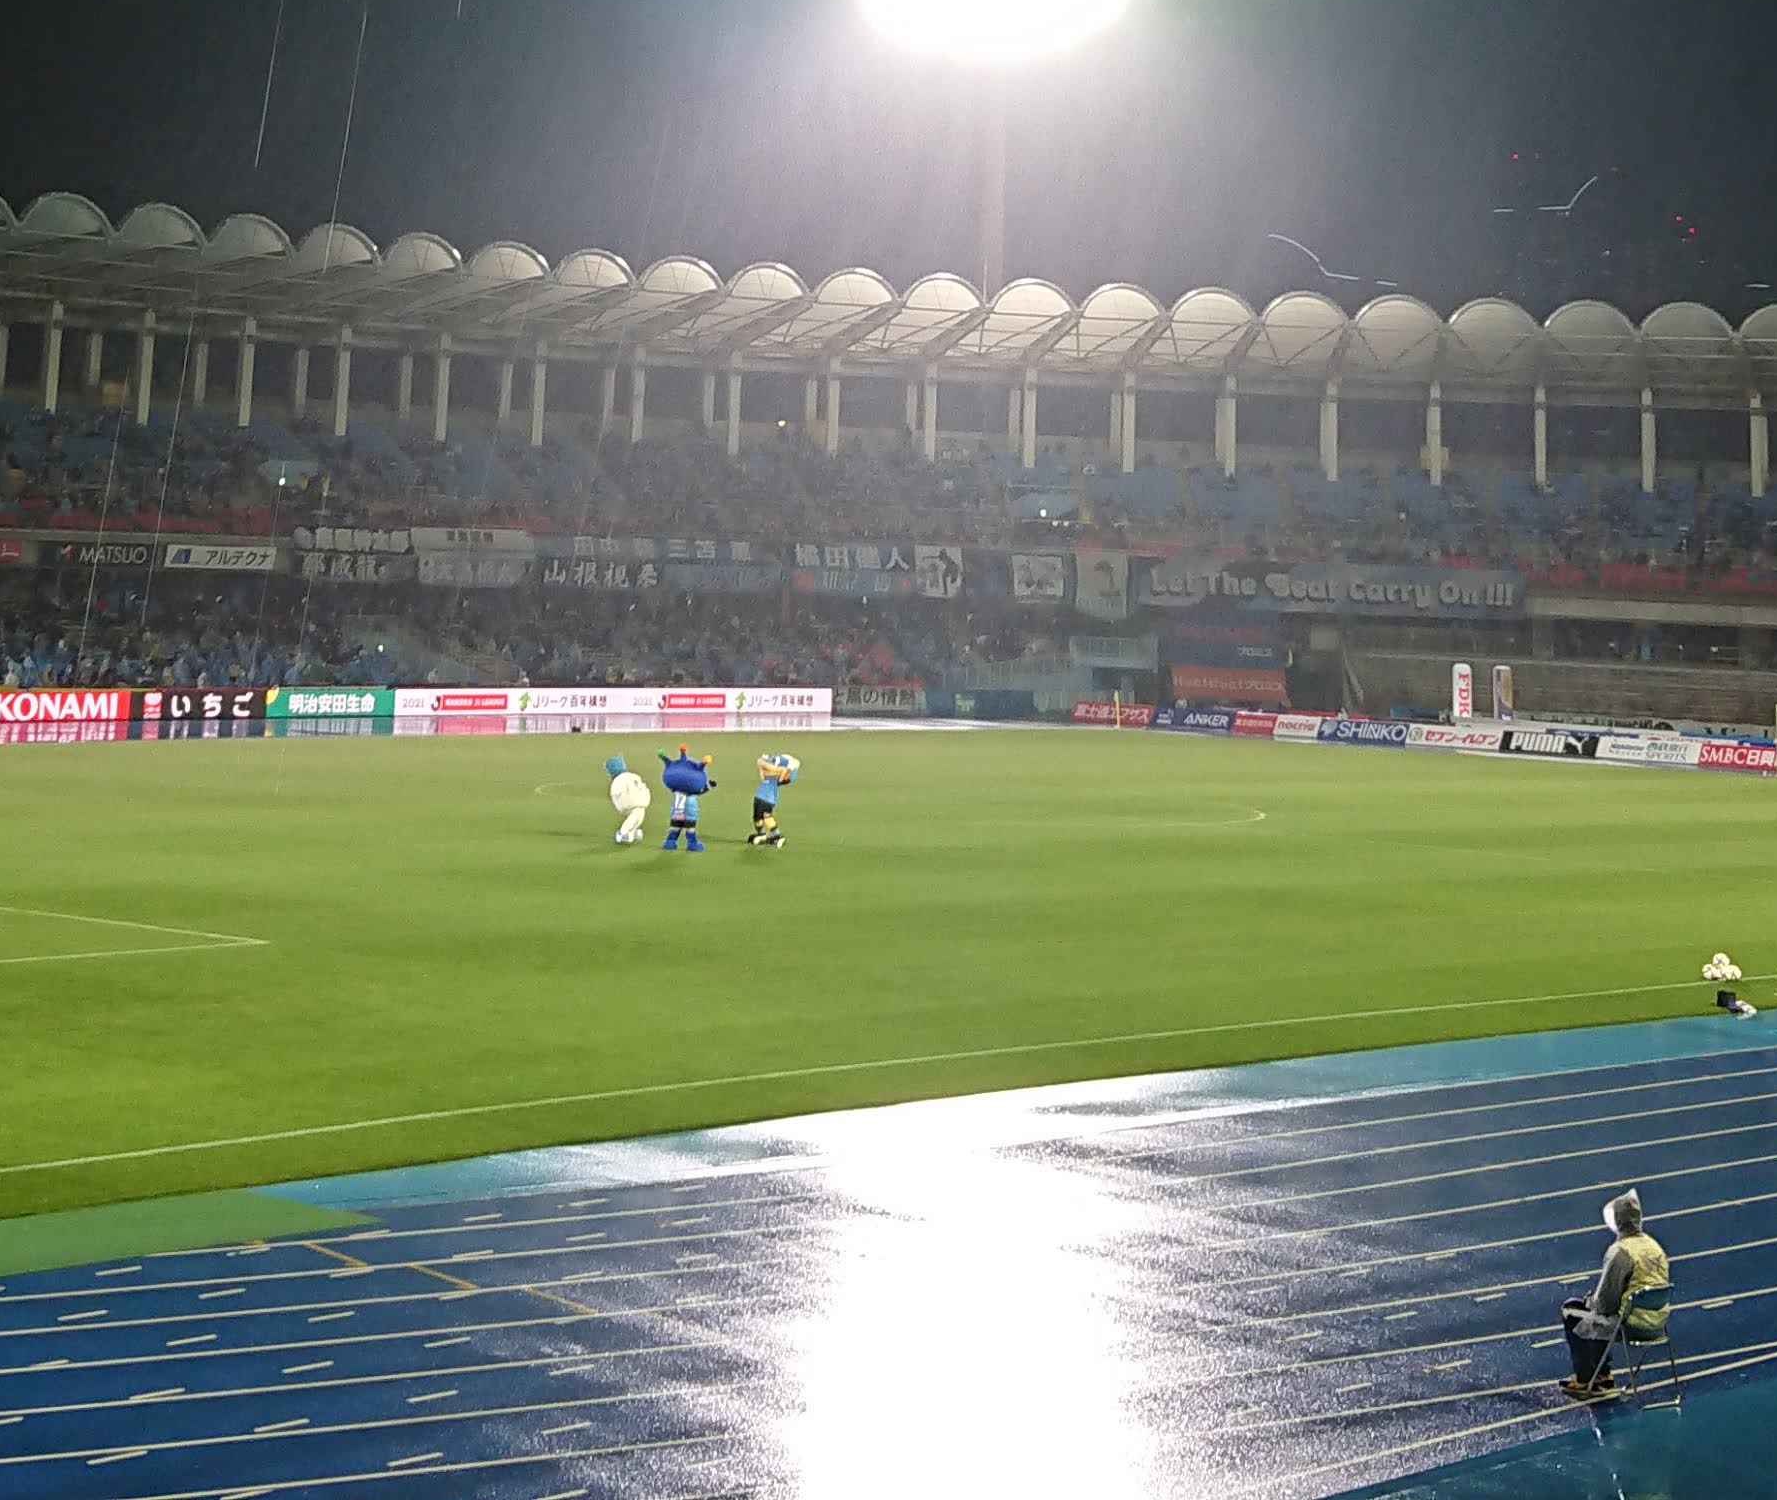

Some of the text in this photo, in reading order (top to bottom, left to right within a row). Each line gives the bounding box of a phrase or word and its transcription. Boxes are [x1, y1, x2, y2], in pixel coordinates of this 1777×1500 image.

[77, 545, 147, 565] MATSUO
[206, 548, 270, 568] アルテクナ
[288, 693, 376, 713] 明治安田生命
[532, 694, 608, 709] Jリーグ百年構想
[747, 694, 814, 707] Jリーグ百年構想
[1458, 671, 1470, 718] FDK
[170, 692, 254, 718] いちご
[1183, 712, 1230, 728] ANKER
[1336, 722, 1408, 742] SHINKO
[1510, 732, 1567, 754] PUMA
